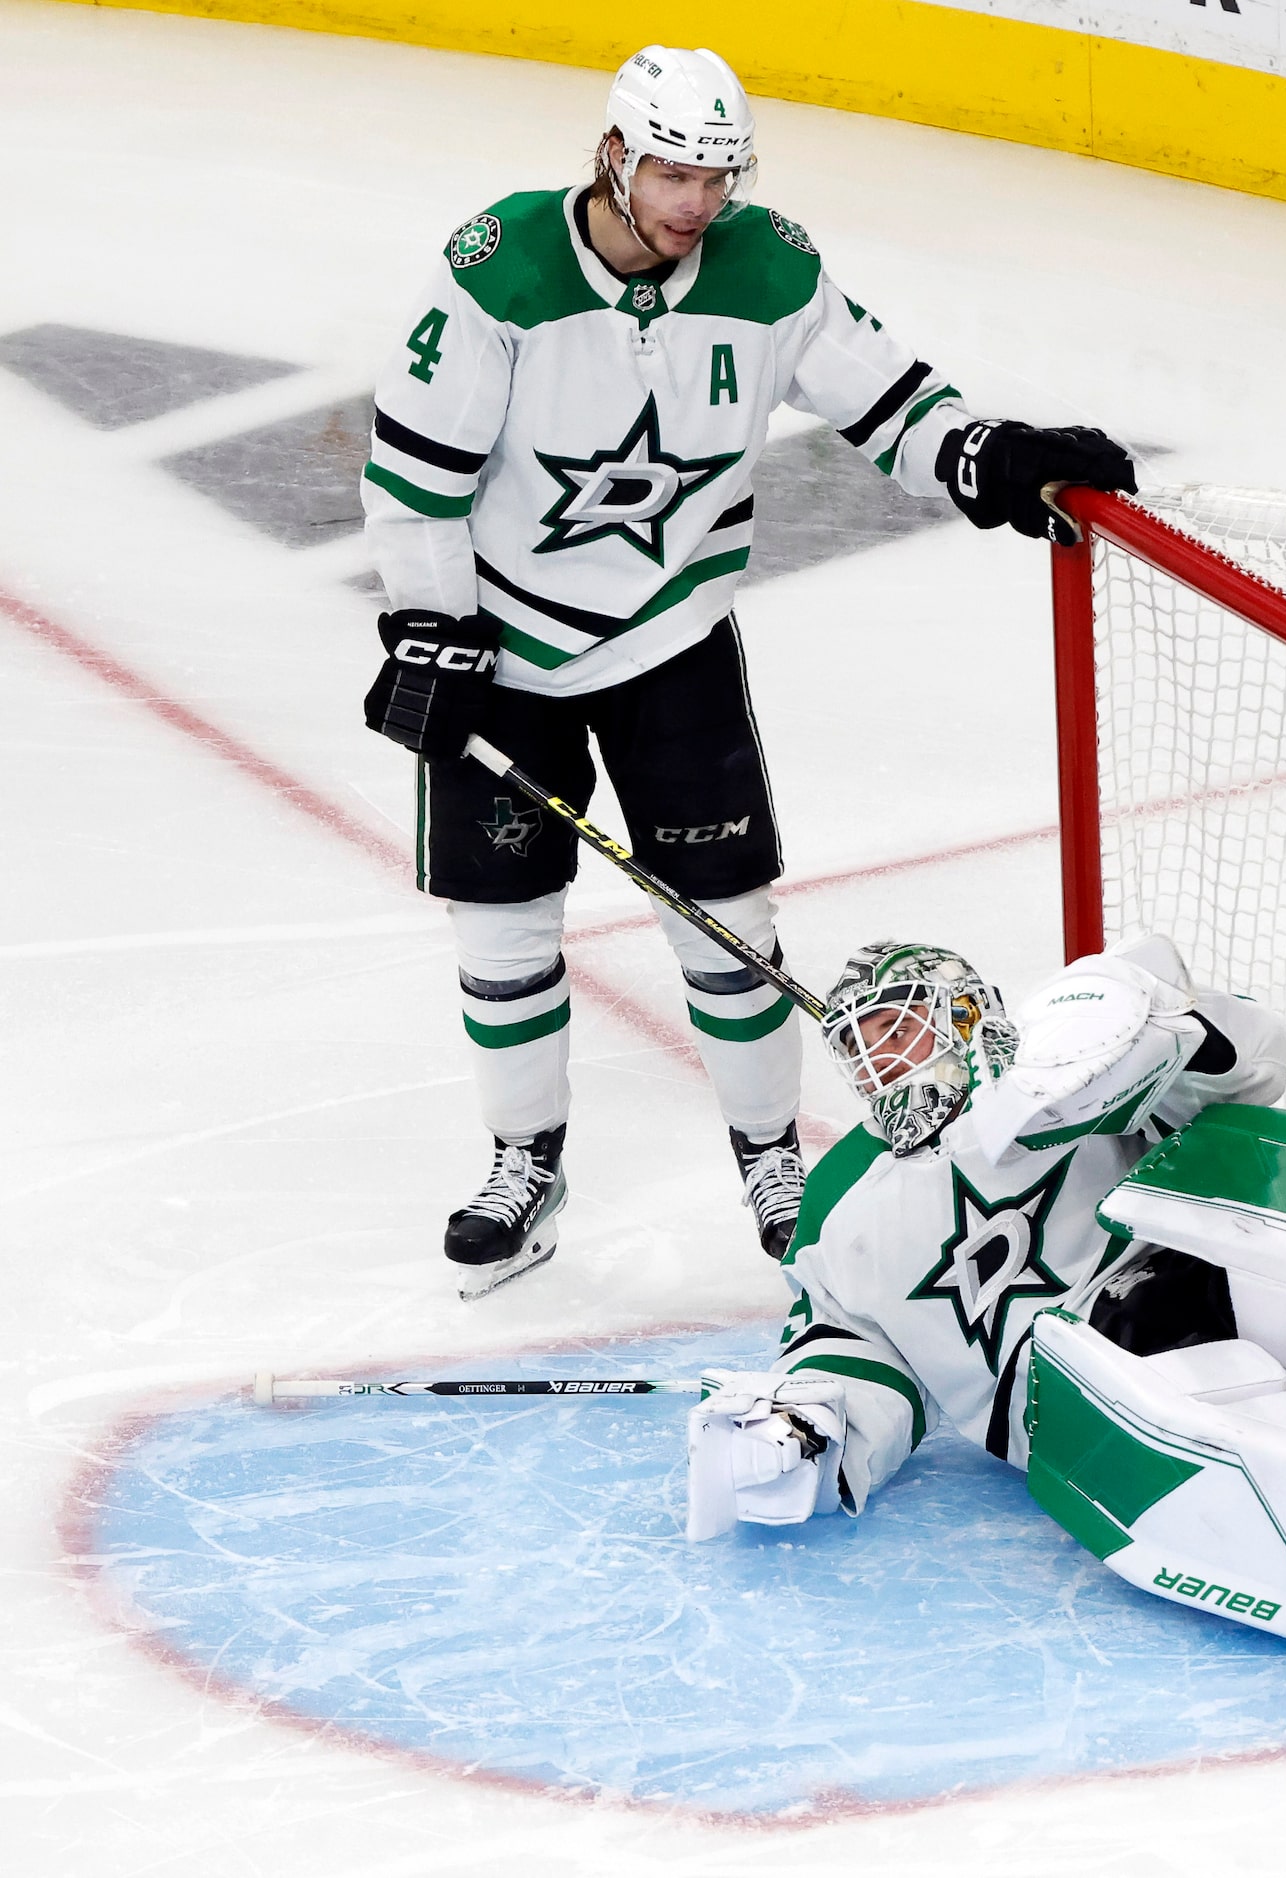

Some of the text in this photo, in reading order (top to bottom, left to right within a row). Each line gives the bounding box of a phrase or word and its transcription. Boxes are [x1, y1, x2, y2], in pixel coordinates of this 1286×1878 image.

[714, 98, 726, 118] 4
[697, 135, 740, 146] CCM
[406, 307, 449, 384] 4
[710, 343, 739, 406] A
[394, 638, 499, 672] CCM
[547, 796, 634, 861] CCM
[653, 815, 752, 845] CCM
[1047, 992, 1105, 1006] MACH
[458, 1384, 507, 1393] OETTINGER
[564, 1382, 637, 1393] BAUER
[1153, 1566, 1282, 1623] BAUER
